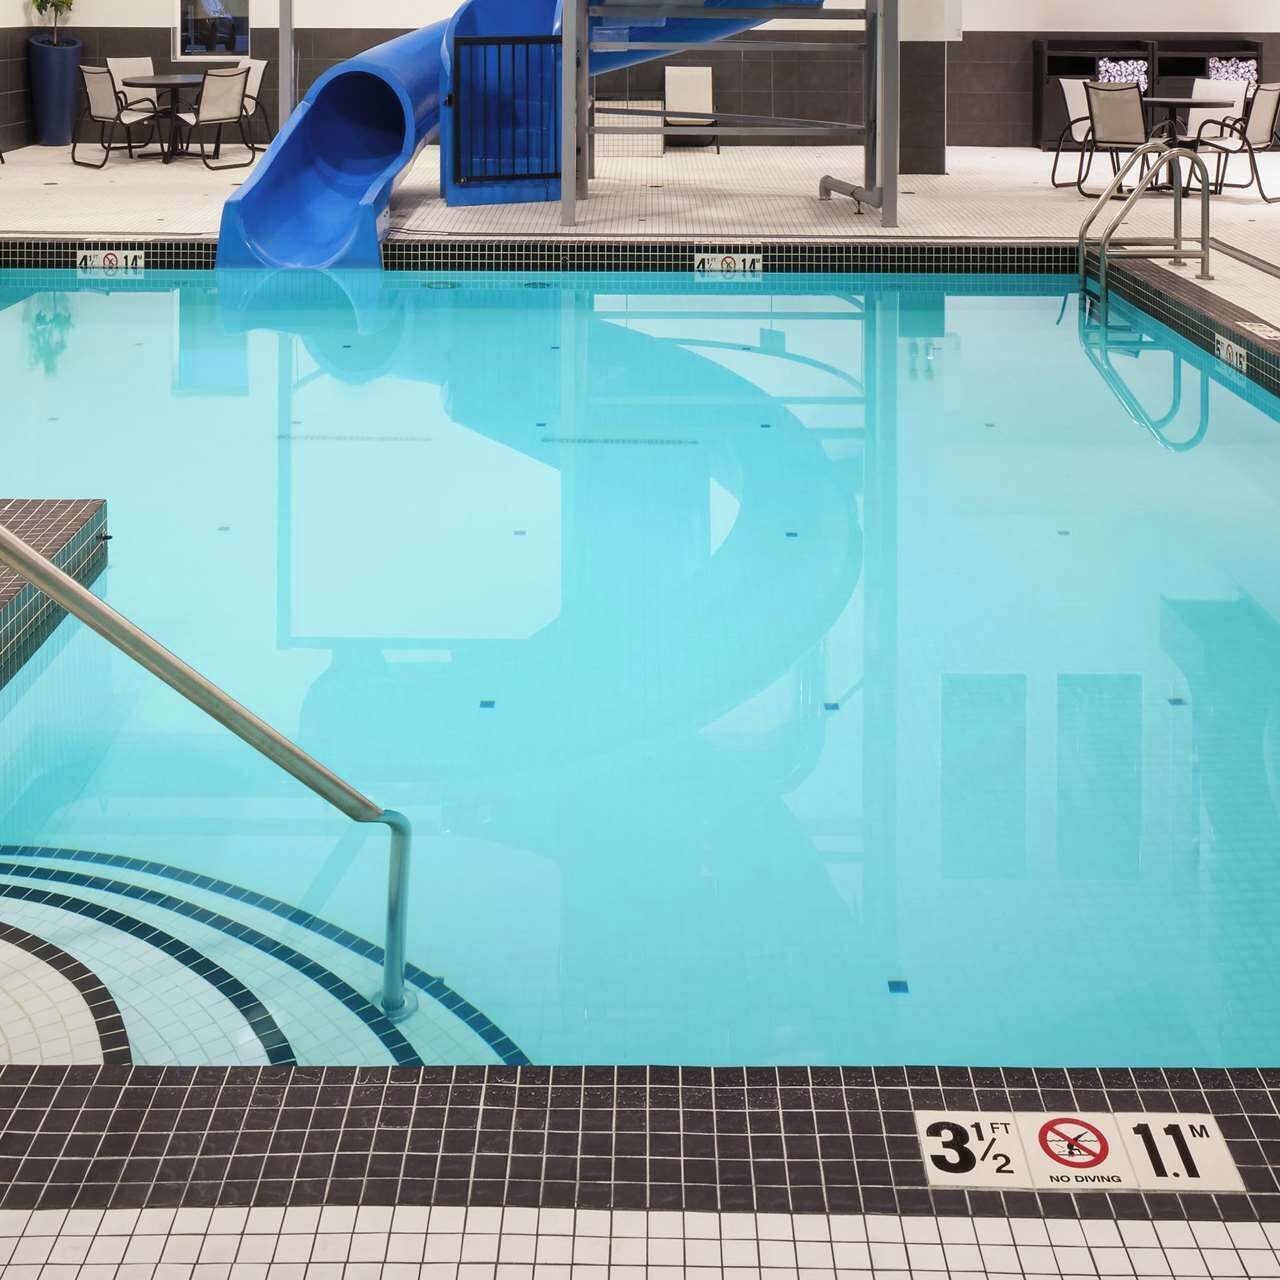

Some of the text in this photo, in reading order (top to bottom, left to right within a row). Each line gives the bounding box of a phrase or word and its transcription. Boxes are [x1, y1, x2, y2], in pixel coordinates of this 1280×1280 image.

[990, 1122, 1011, 1134] FT
[1189, 1124, 1211, 1139] M
[1049, 1174, 1122, 1184] NO DIVING
